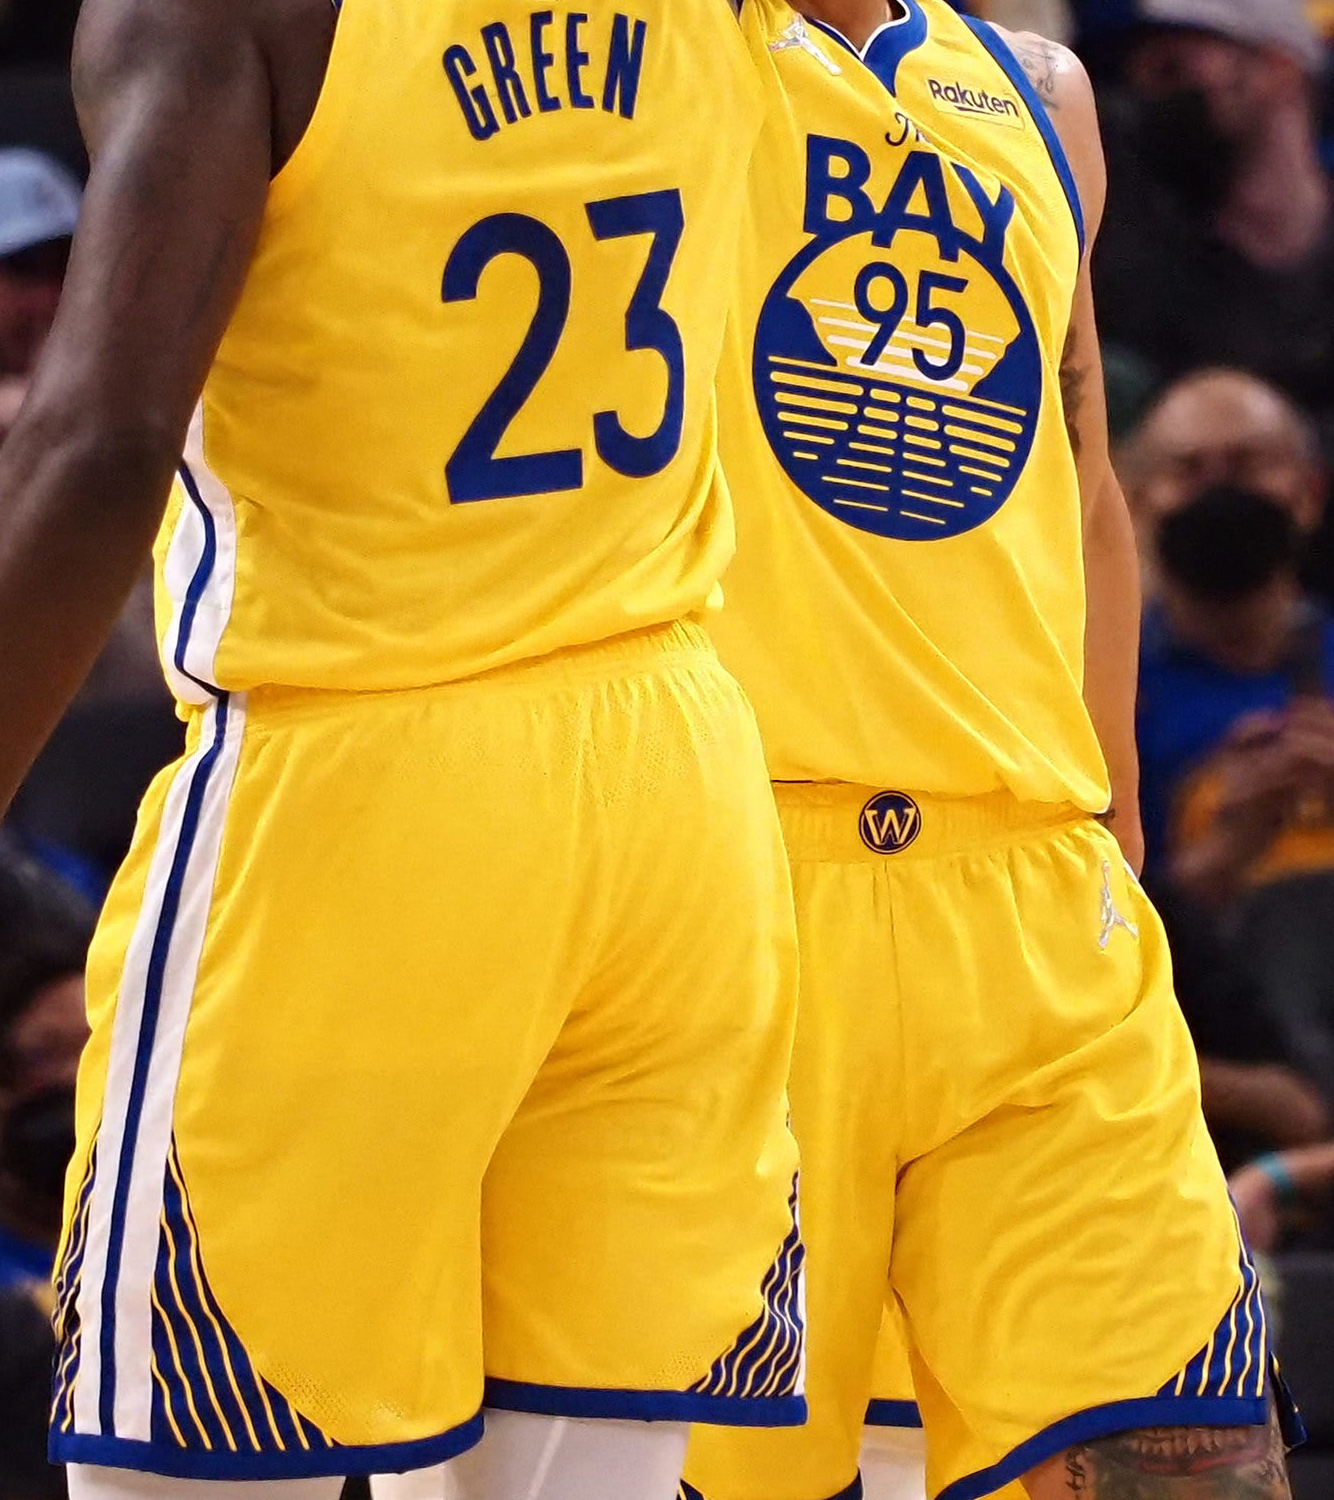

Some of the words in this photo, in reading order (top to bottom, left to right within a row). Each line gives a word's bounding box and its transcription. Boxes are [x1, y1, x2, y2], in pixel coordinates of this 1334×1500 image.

[441, 10, 647, 141] GREEN
[928, 79, 1020, 118] Rakuten
[802, 134, 1015, 266] BAY
[440, 188, 685, 505] 23
[853, 261, 969, 382] 95
